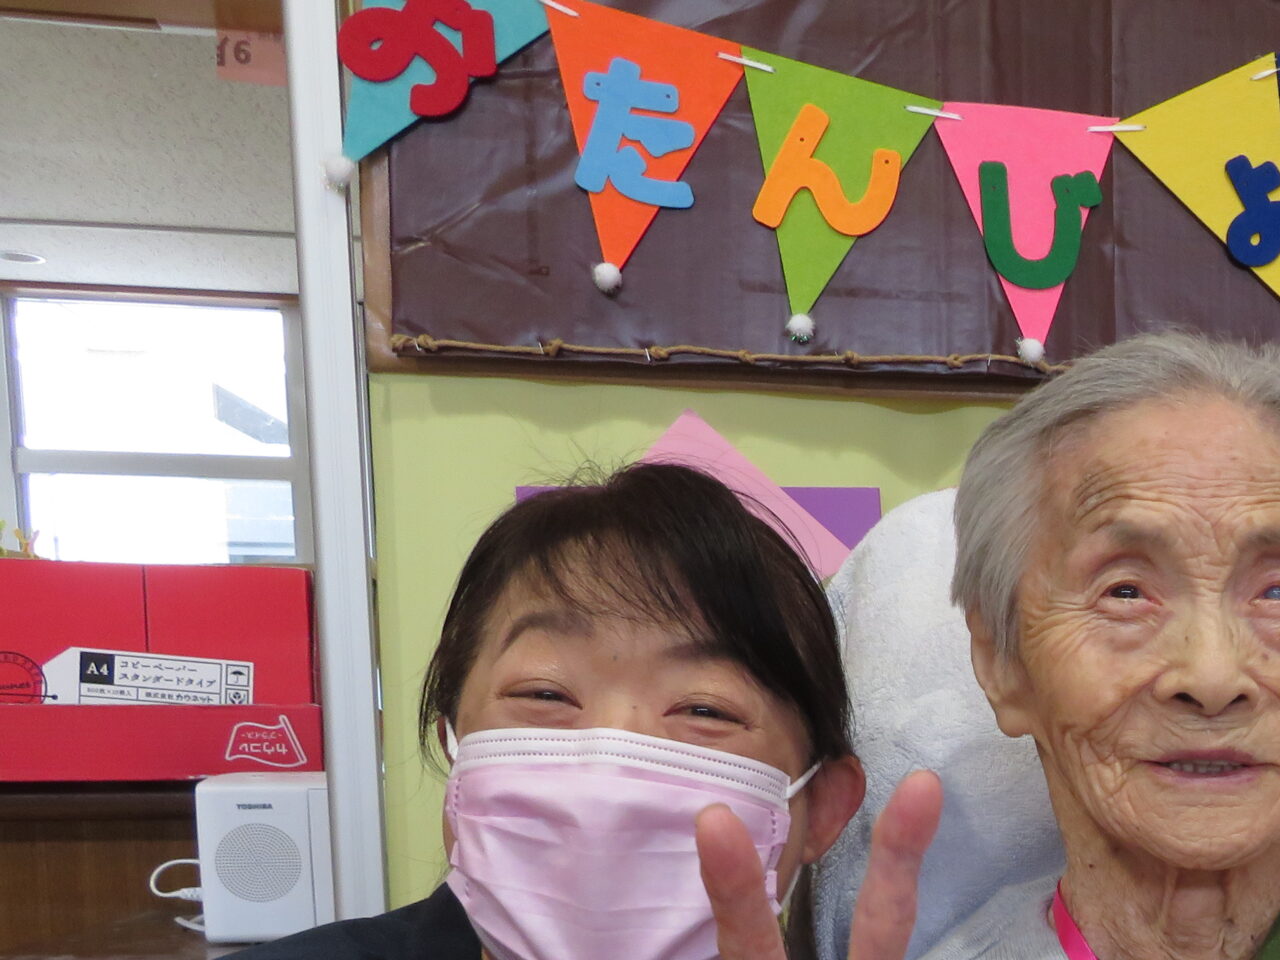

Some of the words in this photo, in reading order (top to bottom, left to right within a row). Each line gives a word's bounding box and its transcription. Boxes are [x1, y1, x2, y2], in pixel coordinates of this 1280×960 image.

[86, 662, 109, 676] A4
[119, 661, 198, 673] コピーペーパー
[118, 673, 217, 688] スタンダードタイプ
